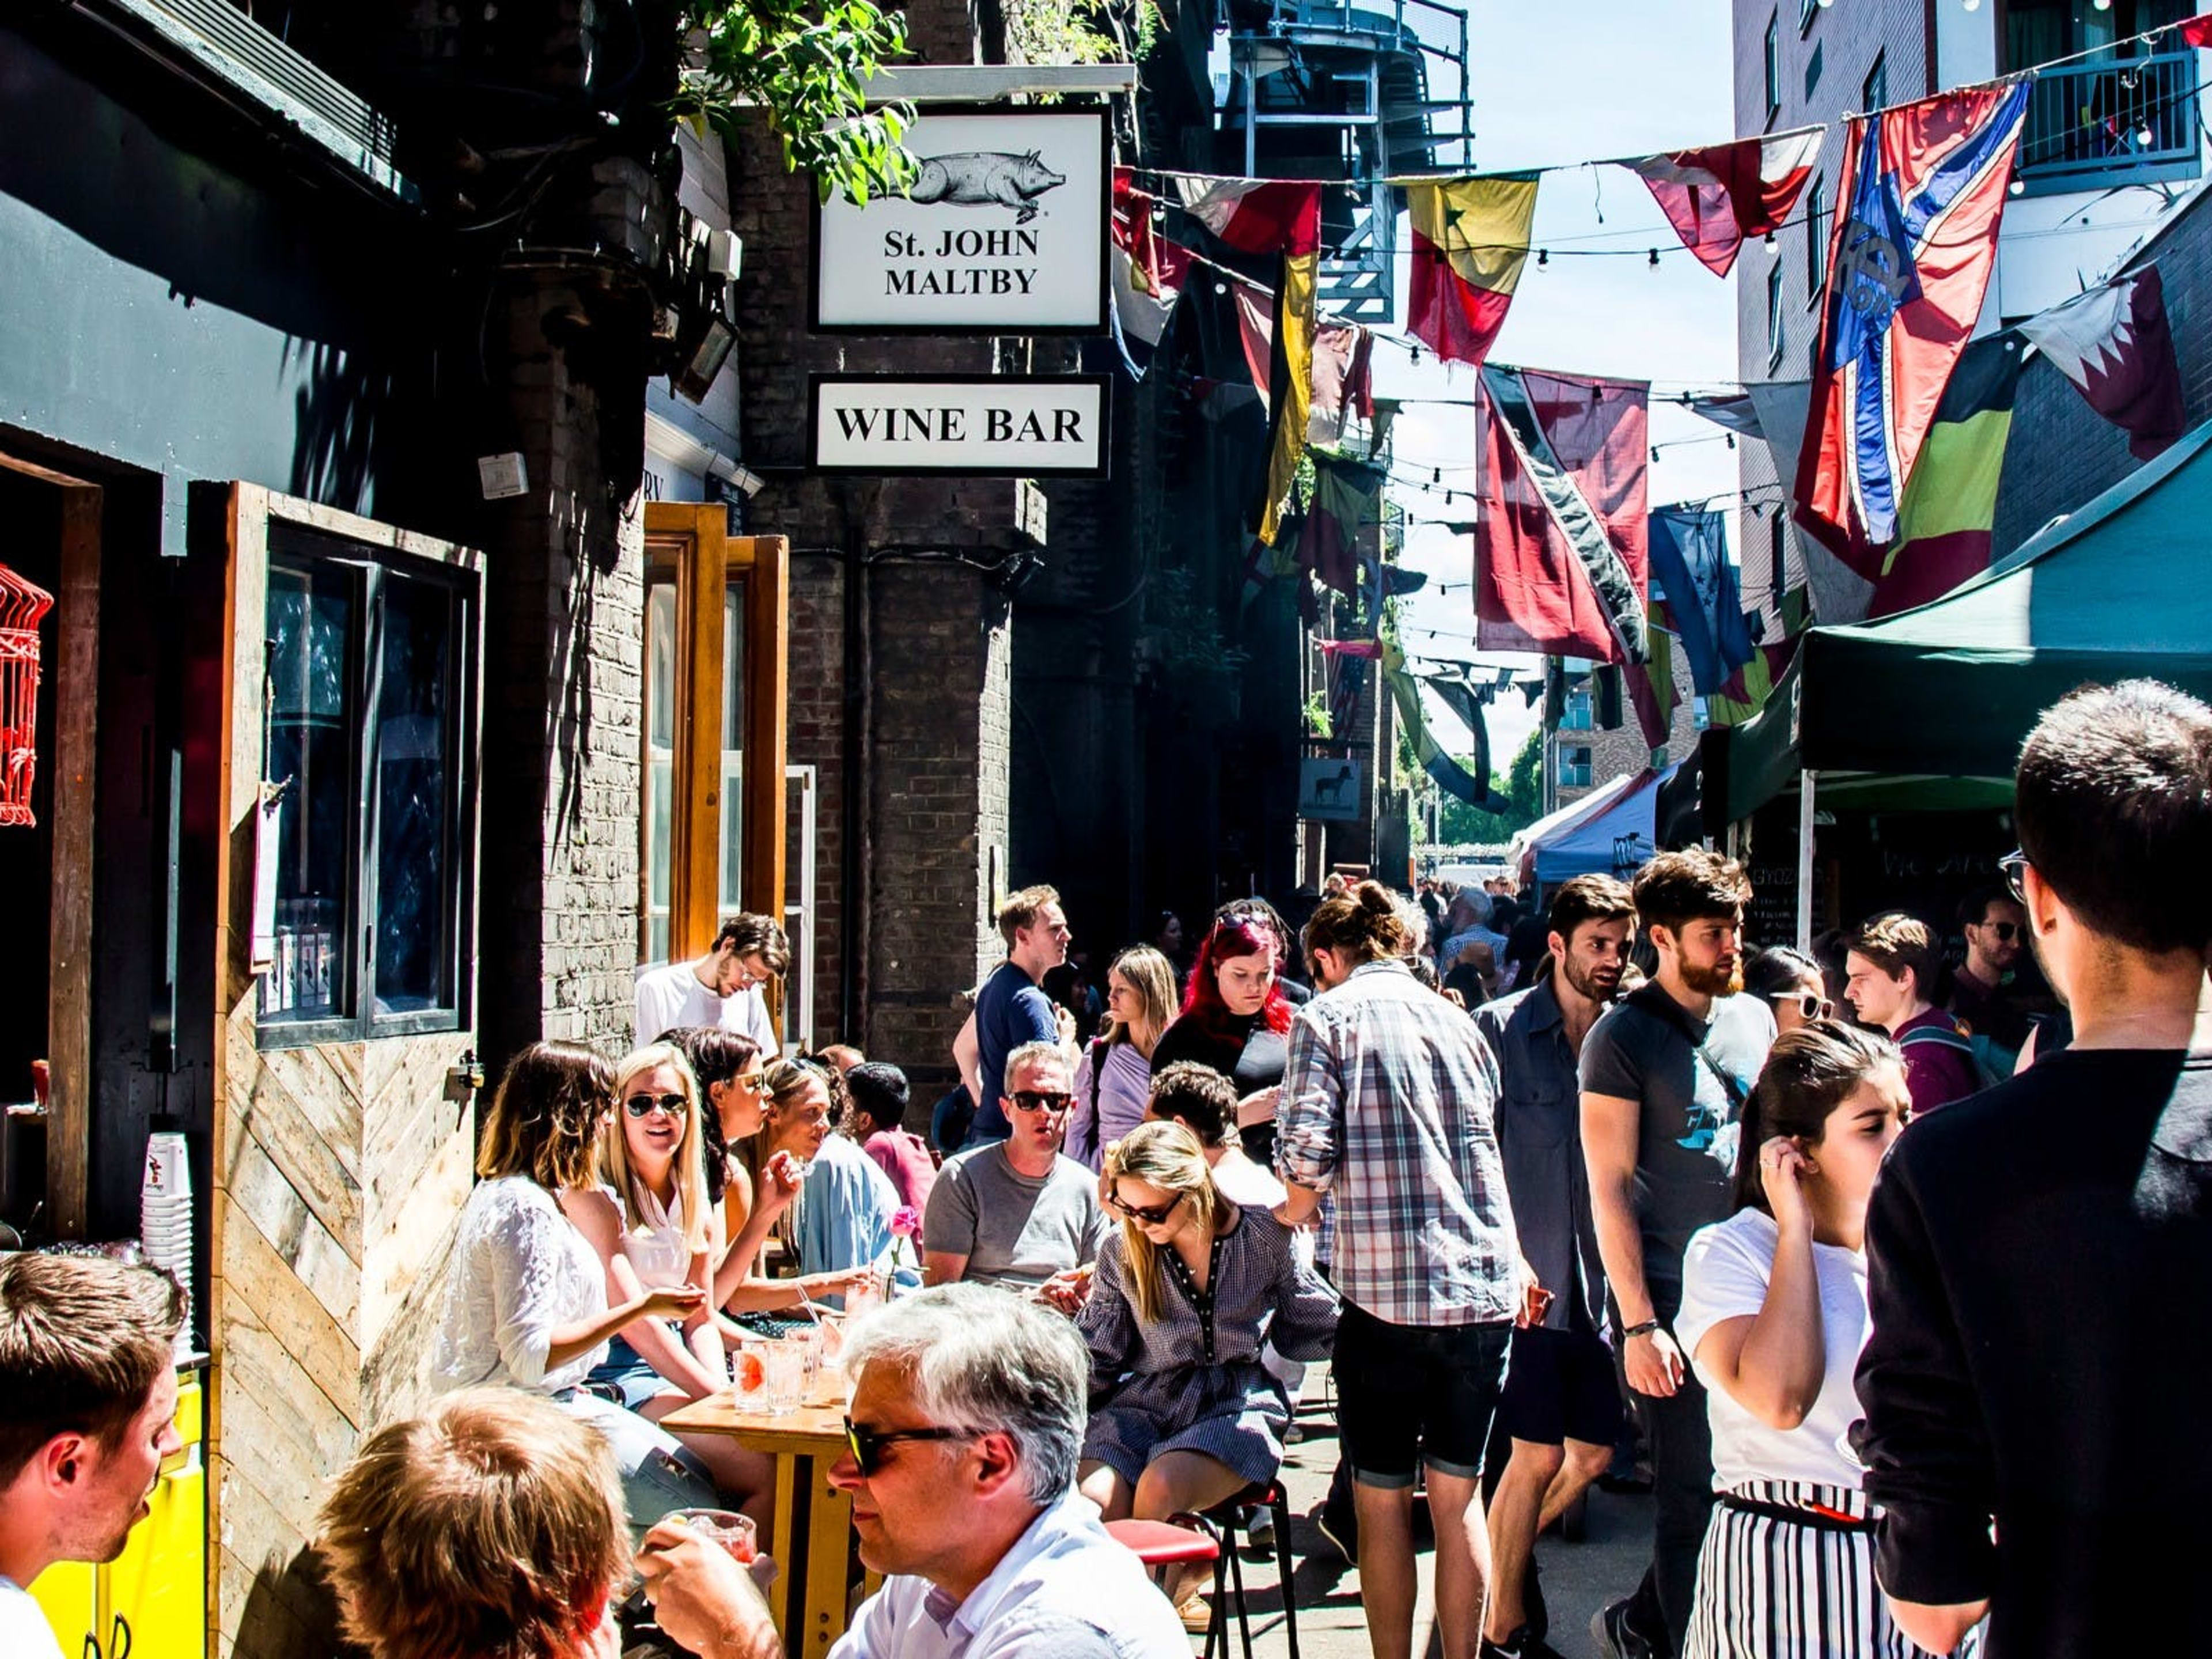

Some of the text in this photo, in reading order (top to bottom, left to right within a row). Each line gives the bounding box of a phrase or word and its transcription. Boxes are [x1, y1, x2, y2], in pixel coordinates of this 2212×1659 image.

[884, 230, 1038, 257] St. JOHN
[885, 269, 1037, 295] MALTBY
[835, 408, 1084, 442] WINE BAR
